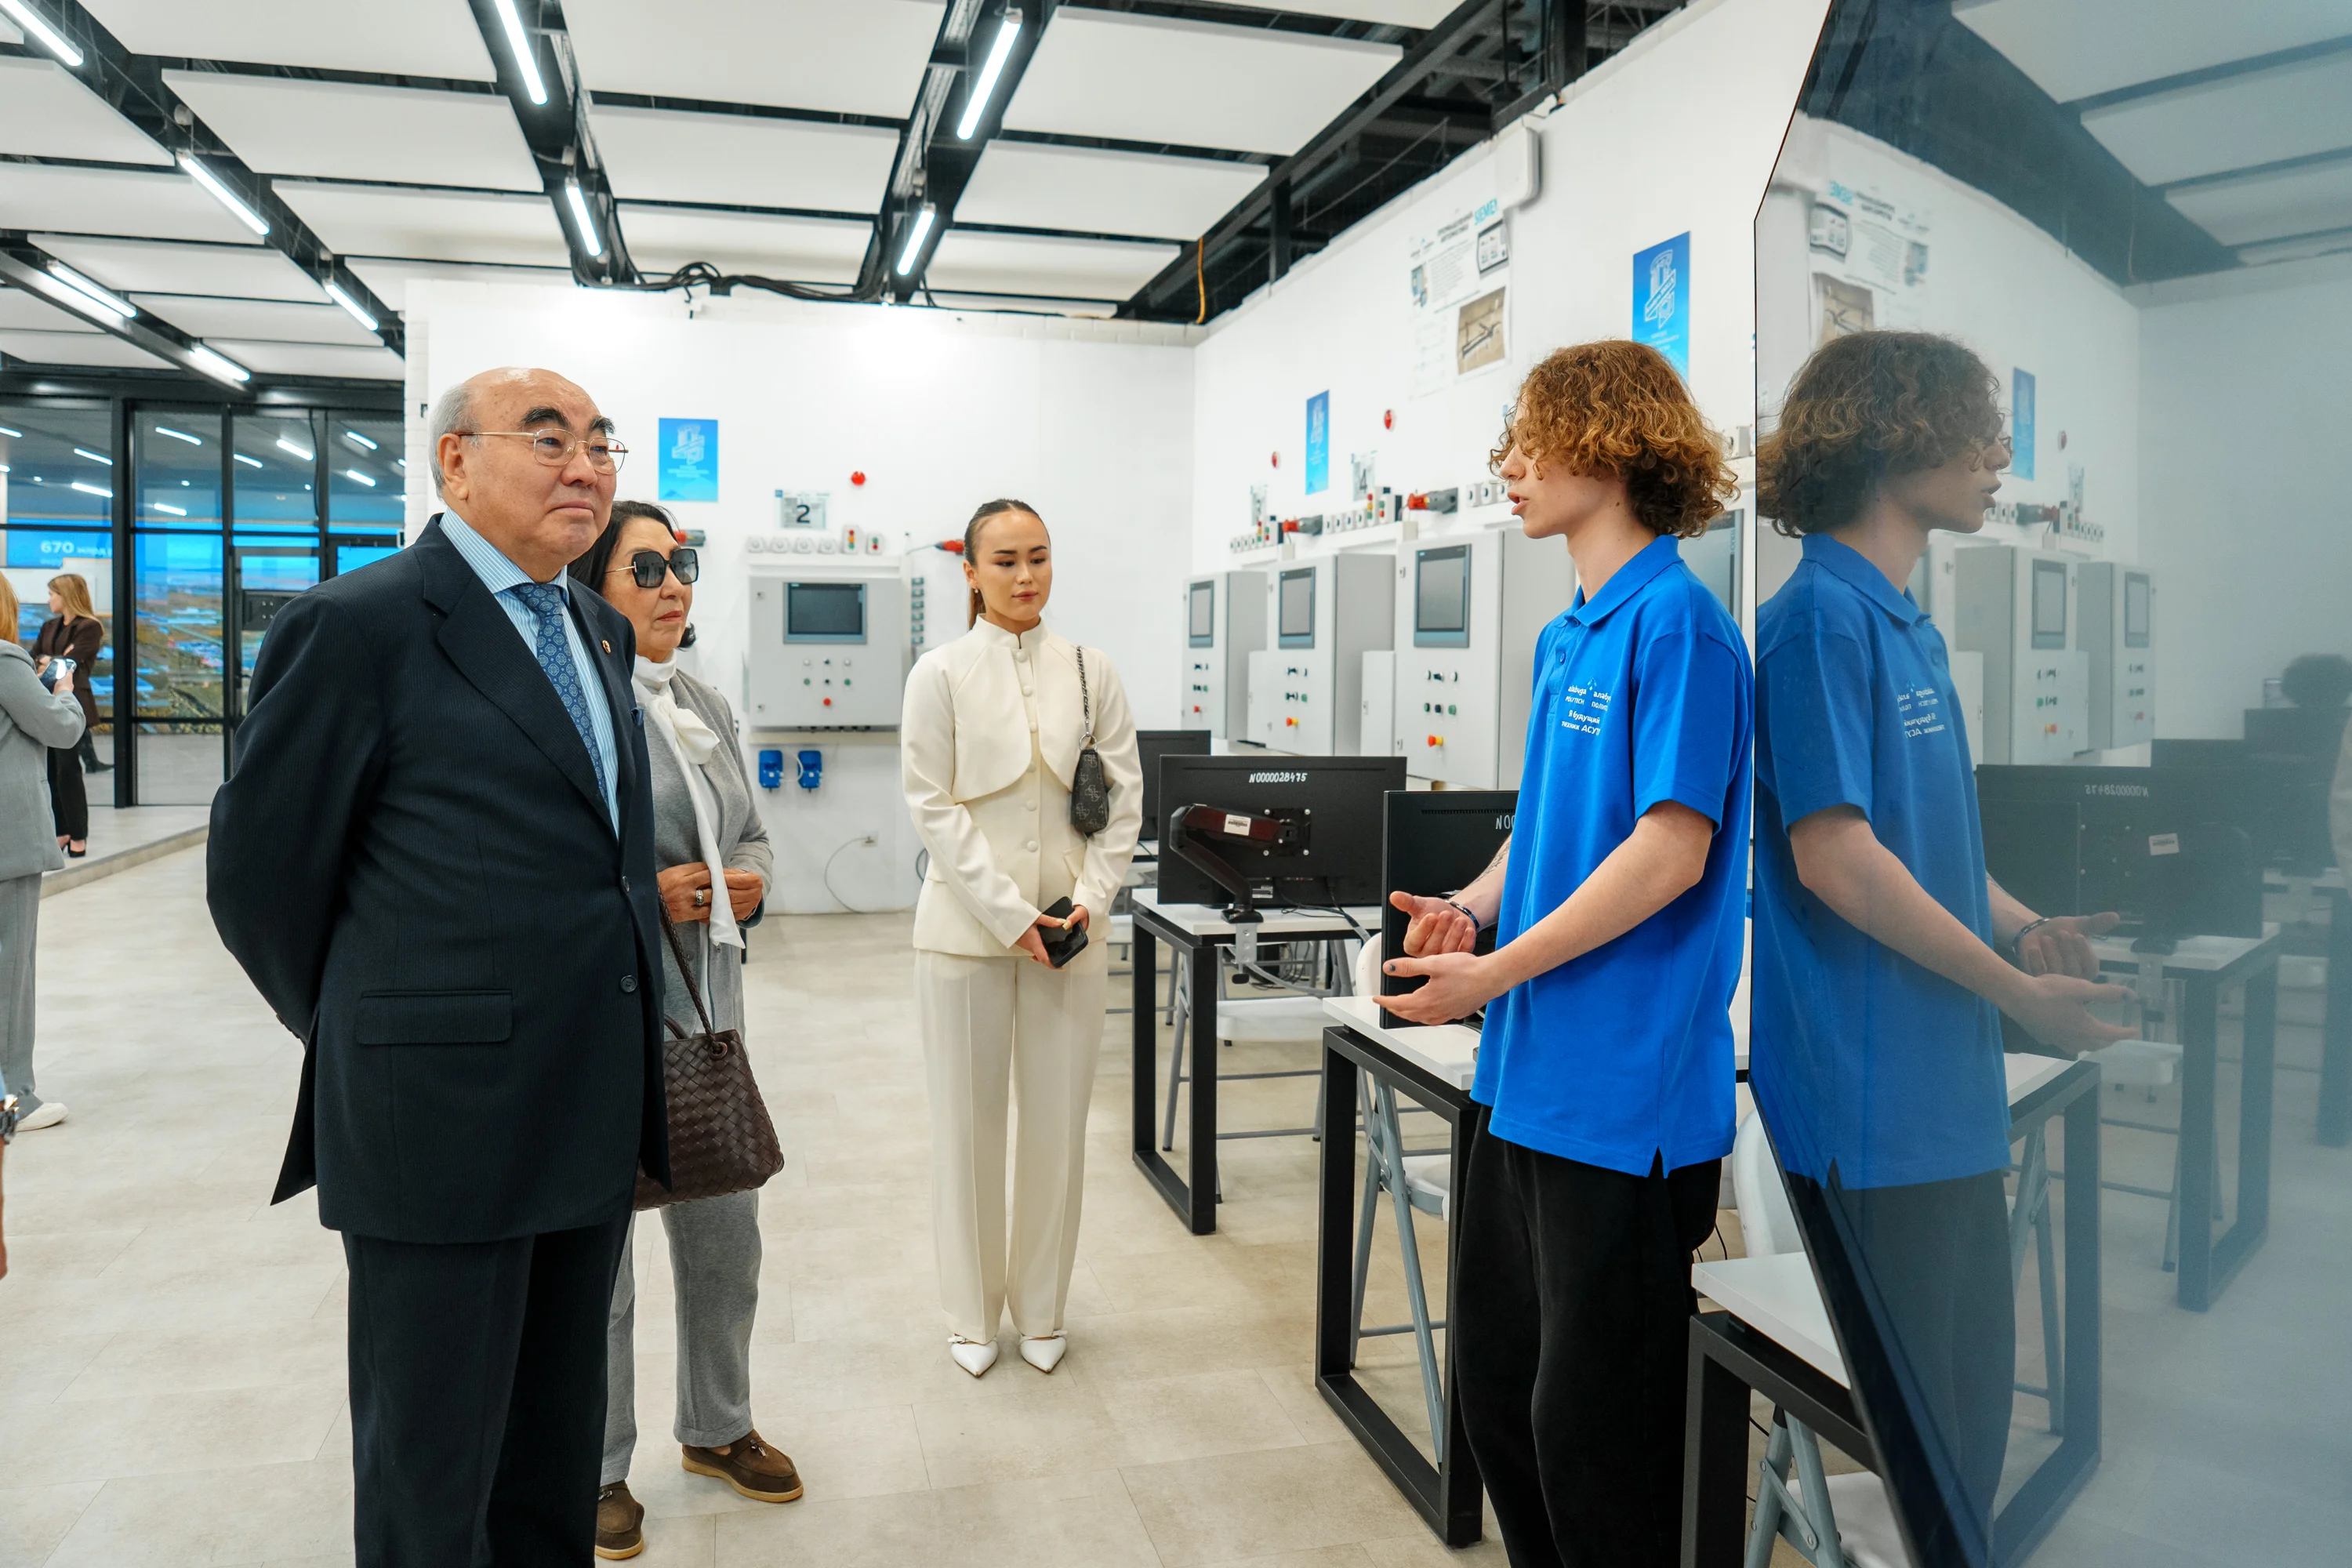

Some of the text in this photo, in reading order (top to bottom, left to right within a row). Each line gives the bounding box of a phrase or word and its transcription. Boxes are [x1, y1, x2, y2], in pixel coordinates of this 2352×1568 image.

[796, 504, 811, 524] 2
[41, 540, 74, 554] 670
[1568, 685, 1587, 696] alabuga
[1573, 711, 1600, 724] будущий
